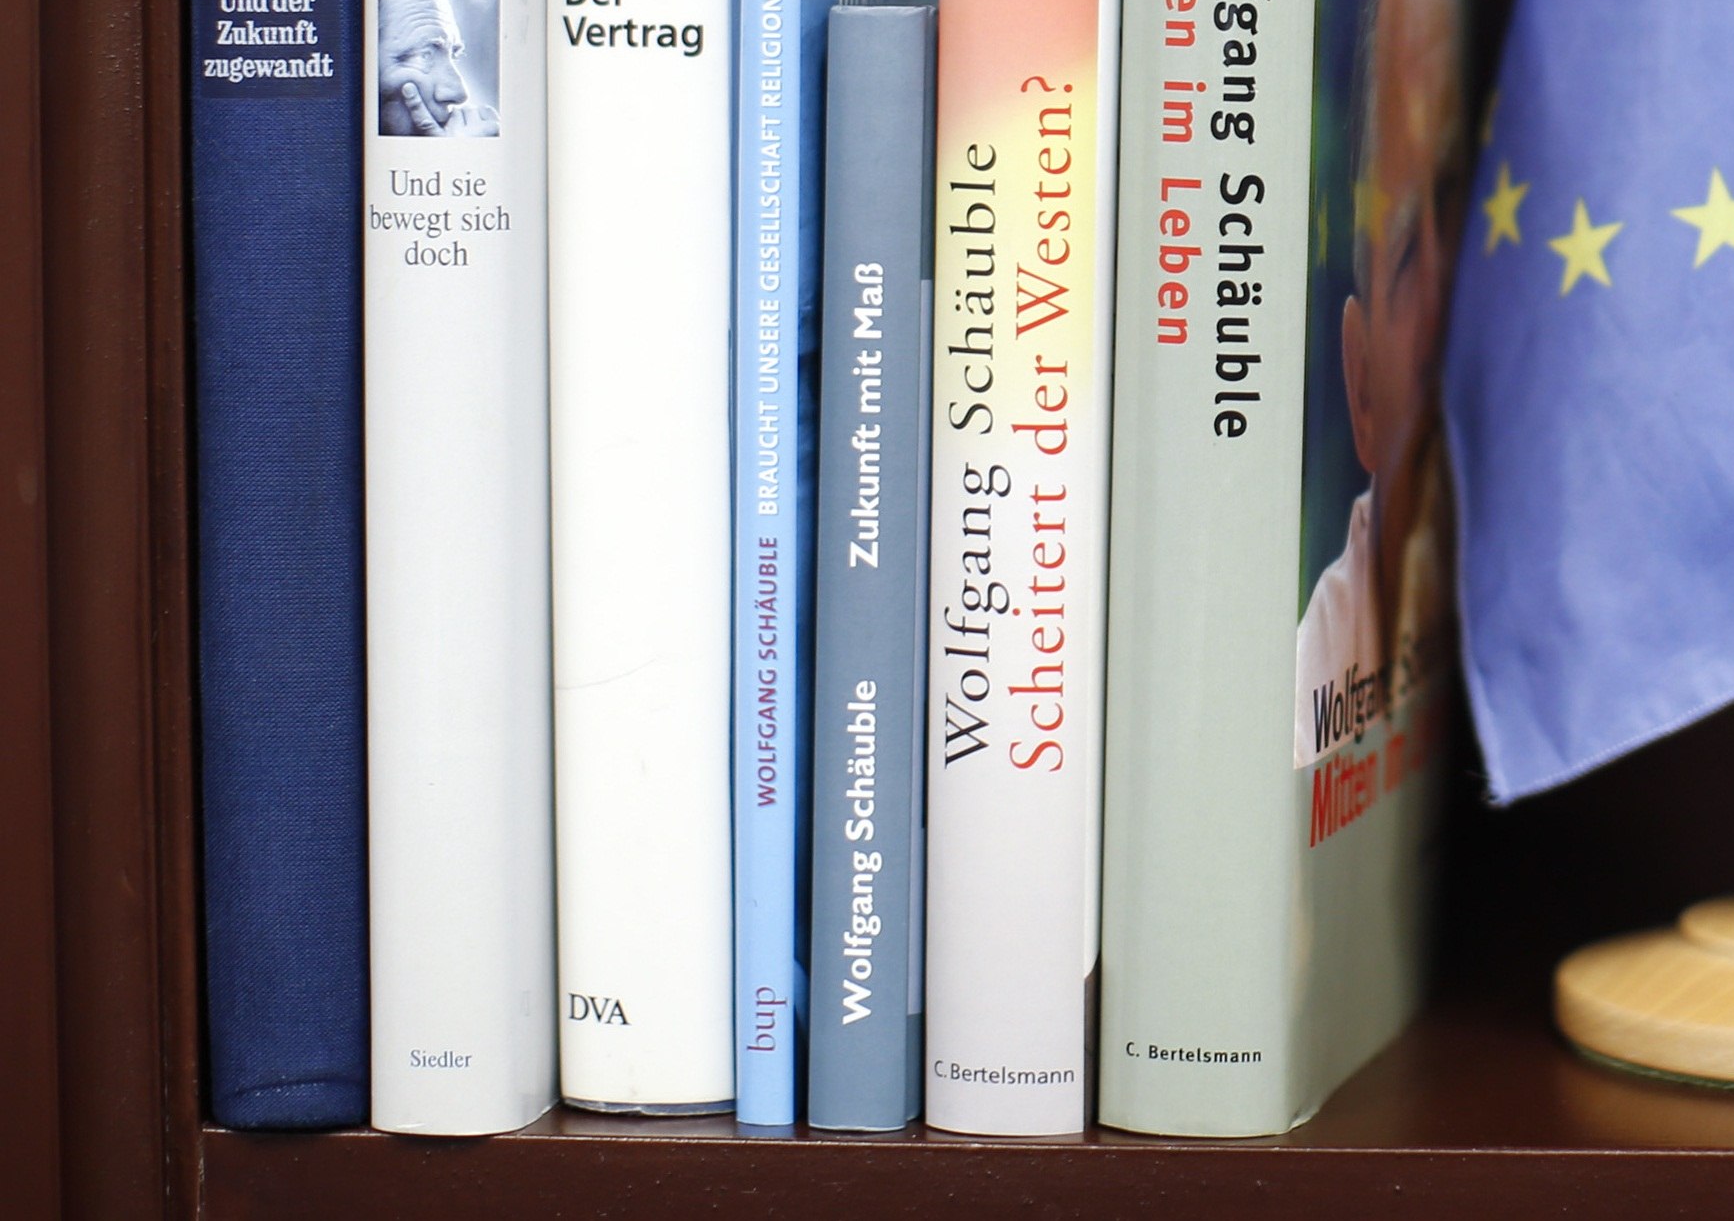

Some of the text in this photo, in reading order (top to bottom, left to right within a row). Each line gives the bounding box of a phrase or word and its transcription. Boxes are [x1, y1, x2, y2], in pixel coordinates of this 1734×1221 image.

[217, 20, 318, 46] Zukunft
[563, 16, 703, 56] Vertrag
[204, 54, 333, 82] zugewandt
[1162, 81, 1208, 144] im
[389, 170, 487, 197] Und sie
[760, 115, 782, 292] GESELLSCHAFT
[370, 204, 511, 238] bewegt sich
[404, 240, 468, 266] doch
[1157, 178, 1202, 345] Leben
[1213, 173, 1264, 439] Schäuble
[759, 299, 780, 396] UNSERE
[850, 263, 885, 568] Zukunft mit Maß
[1007, 75, 1074, 771] Scheitert der Westen?
[757, 399, 780, 515] BRAUCHT
[943, 143, 1012, 770] Wolfgang Schäuble
[755, 536, 779, 807] WOLFGANG SCHÄUBLE
[842, 680, 882, 1025] Wolfgang Schäuble
[567, 992, 630, 1024] DVA
[747, 985, 787, 1052] bup
[410, 1050, 472, 1068] Siedler
[1125, 1042, 1262, 1064] C. Bertelsmann
